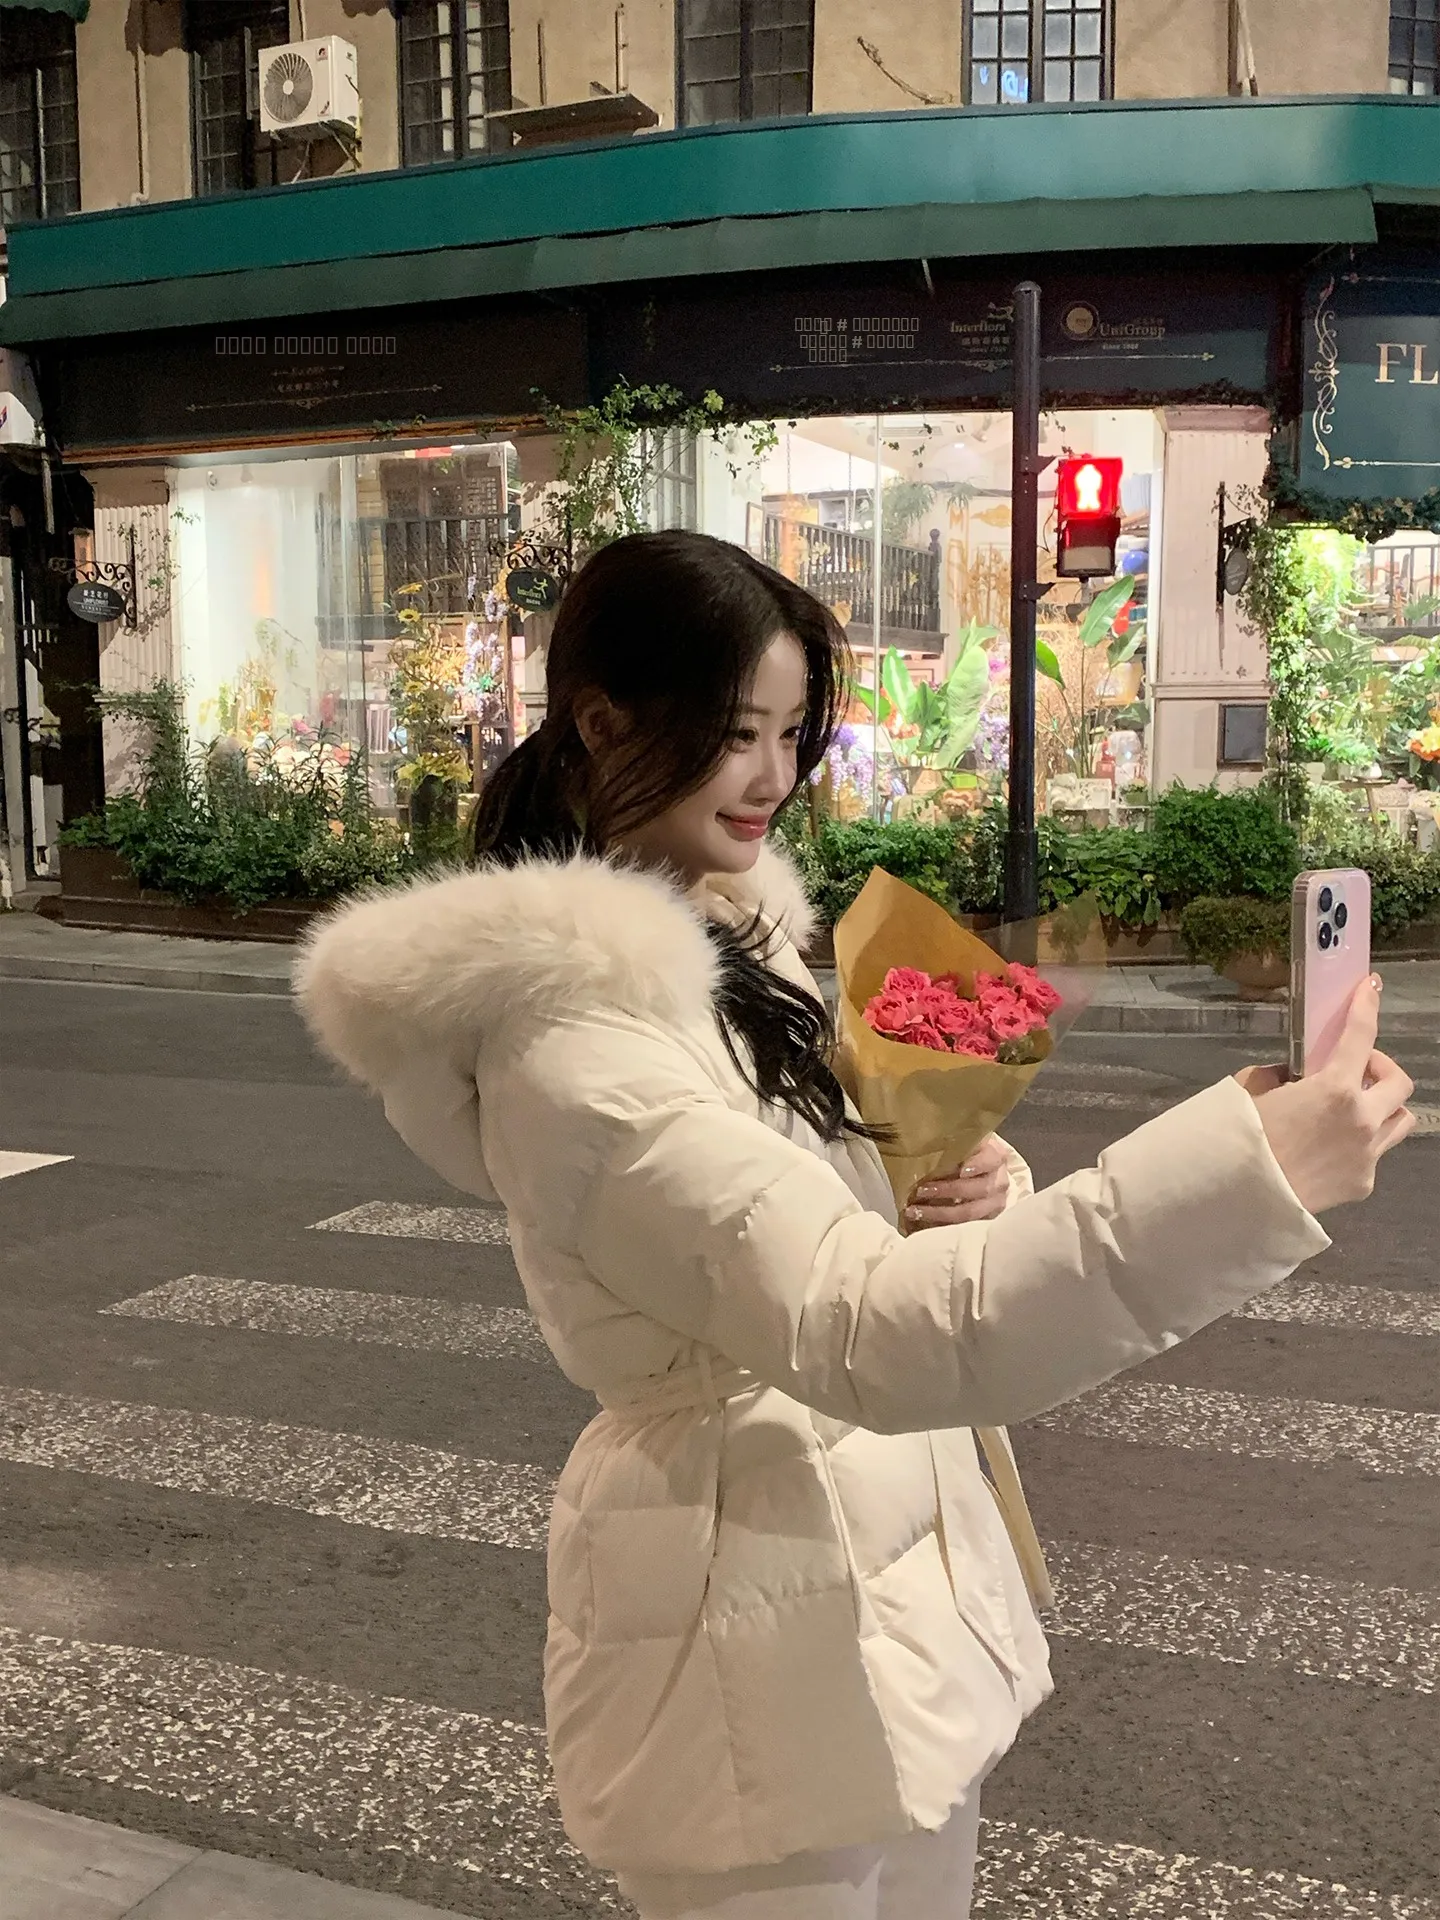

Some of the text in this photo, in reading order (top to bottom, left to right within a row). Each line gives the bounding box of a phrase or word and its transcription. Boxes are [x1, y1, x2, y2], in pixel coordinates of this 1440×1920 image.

[950, 319, 1006, 333] Interflora
[1099, 323, 1166, 339] UniGroup
[1374, 342, 1439, 385] FL
